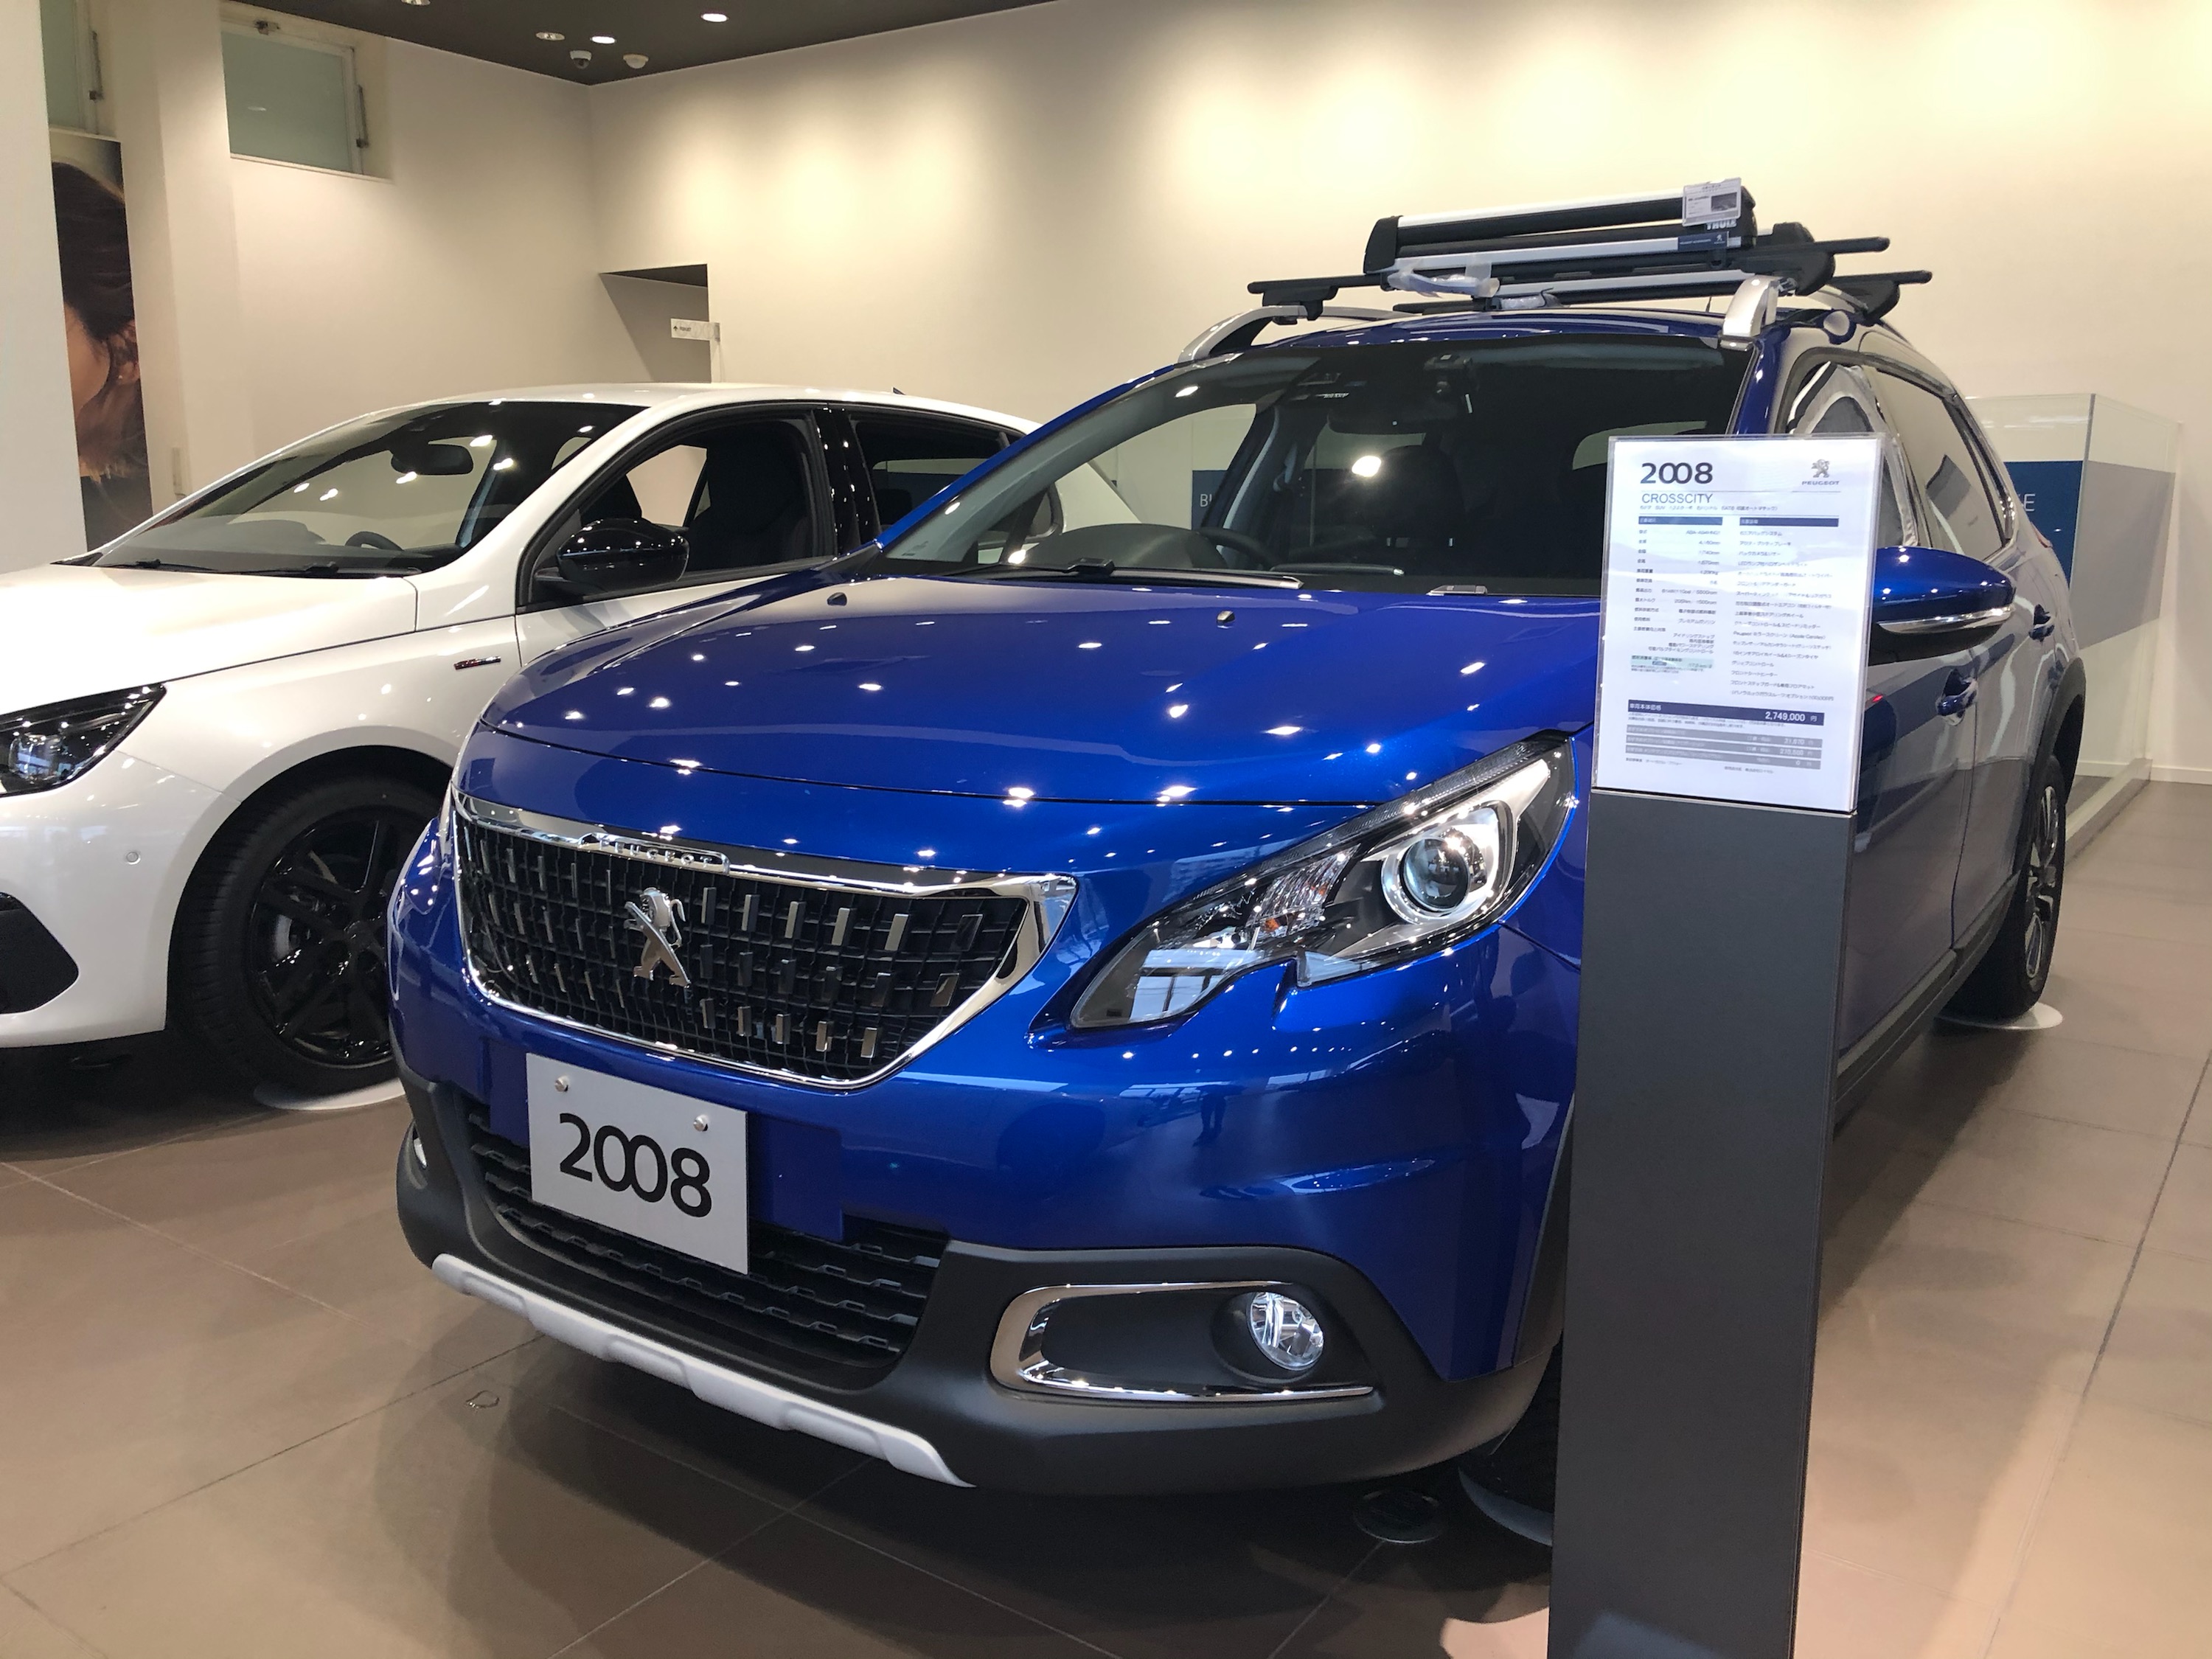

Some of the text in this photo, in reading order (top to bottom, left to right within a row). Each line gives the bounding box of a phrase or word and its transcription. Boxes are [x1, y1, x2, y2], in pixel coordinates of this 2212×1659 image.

[1640, 462, 1713, 484] 2008
[1641, 493, 1713, 504] CROSSCITY
[2018, 493, 2036, 512] E
[1765, 712, 1806, 721] 2,749,000
[560, 1113, 712, 1217] 2008
